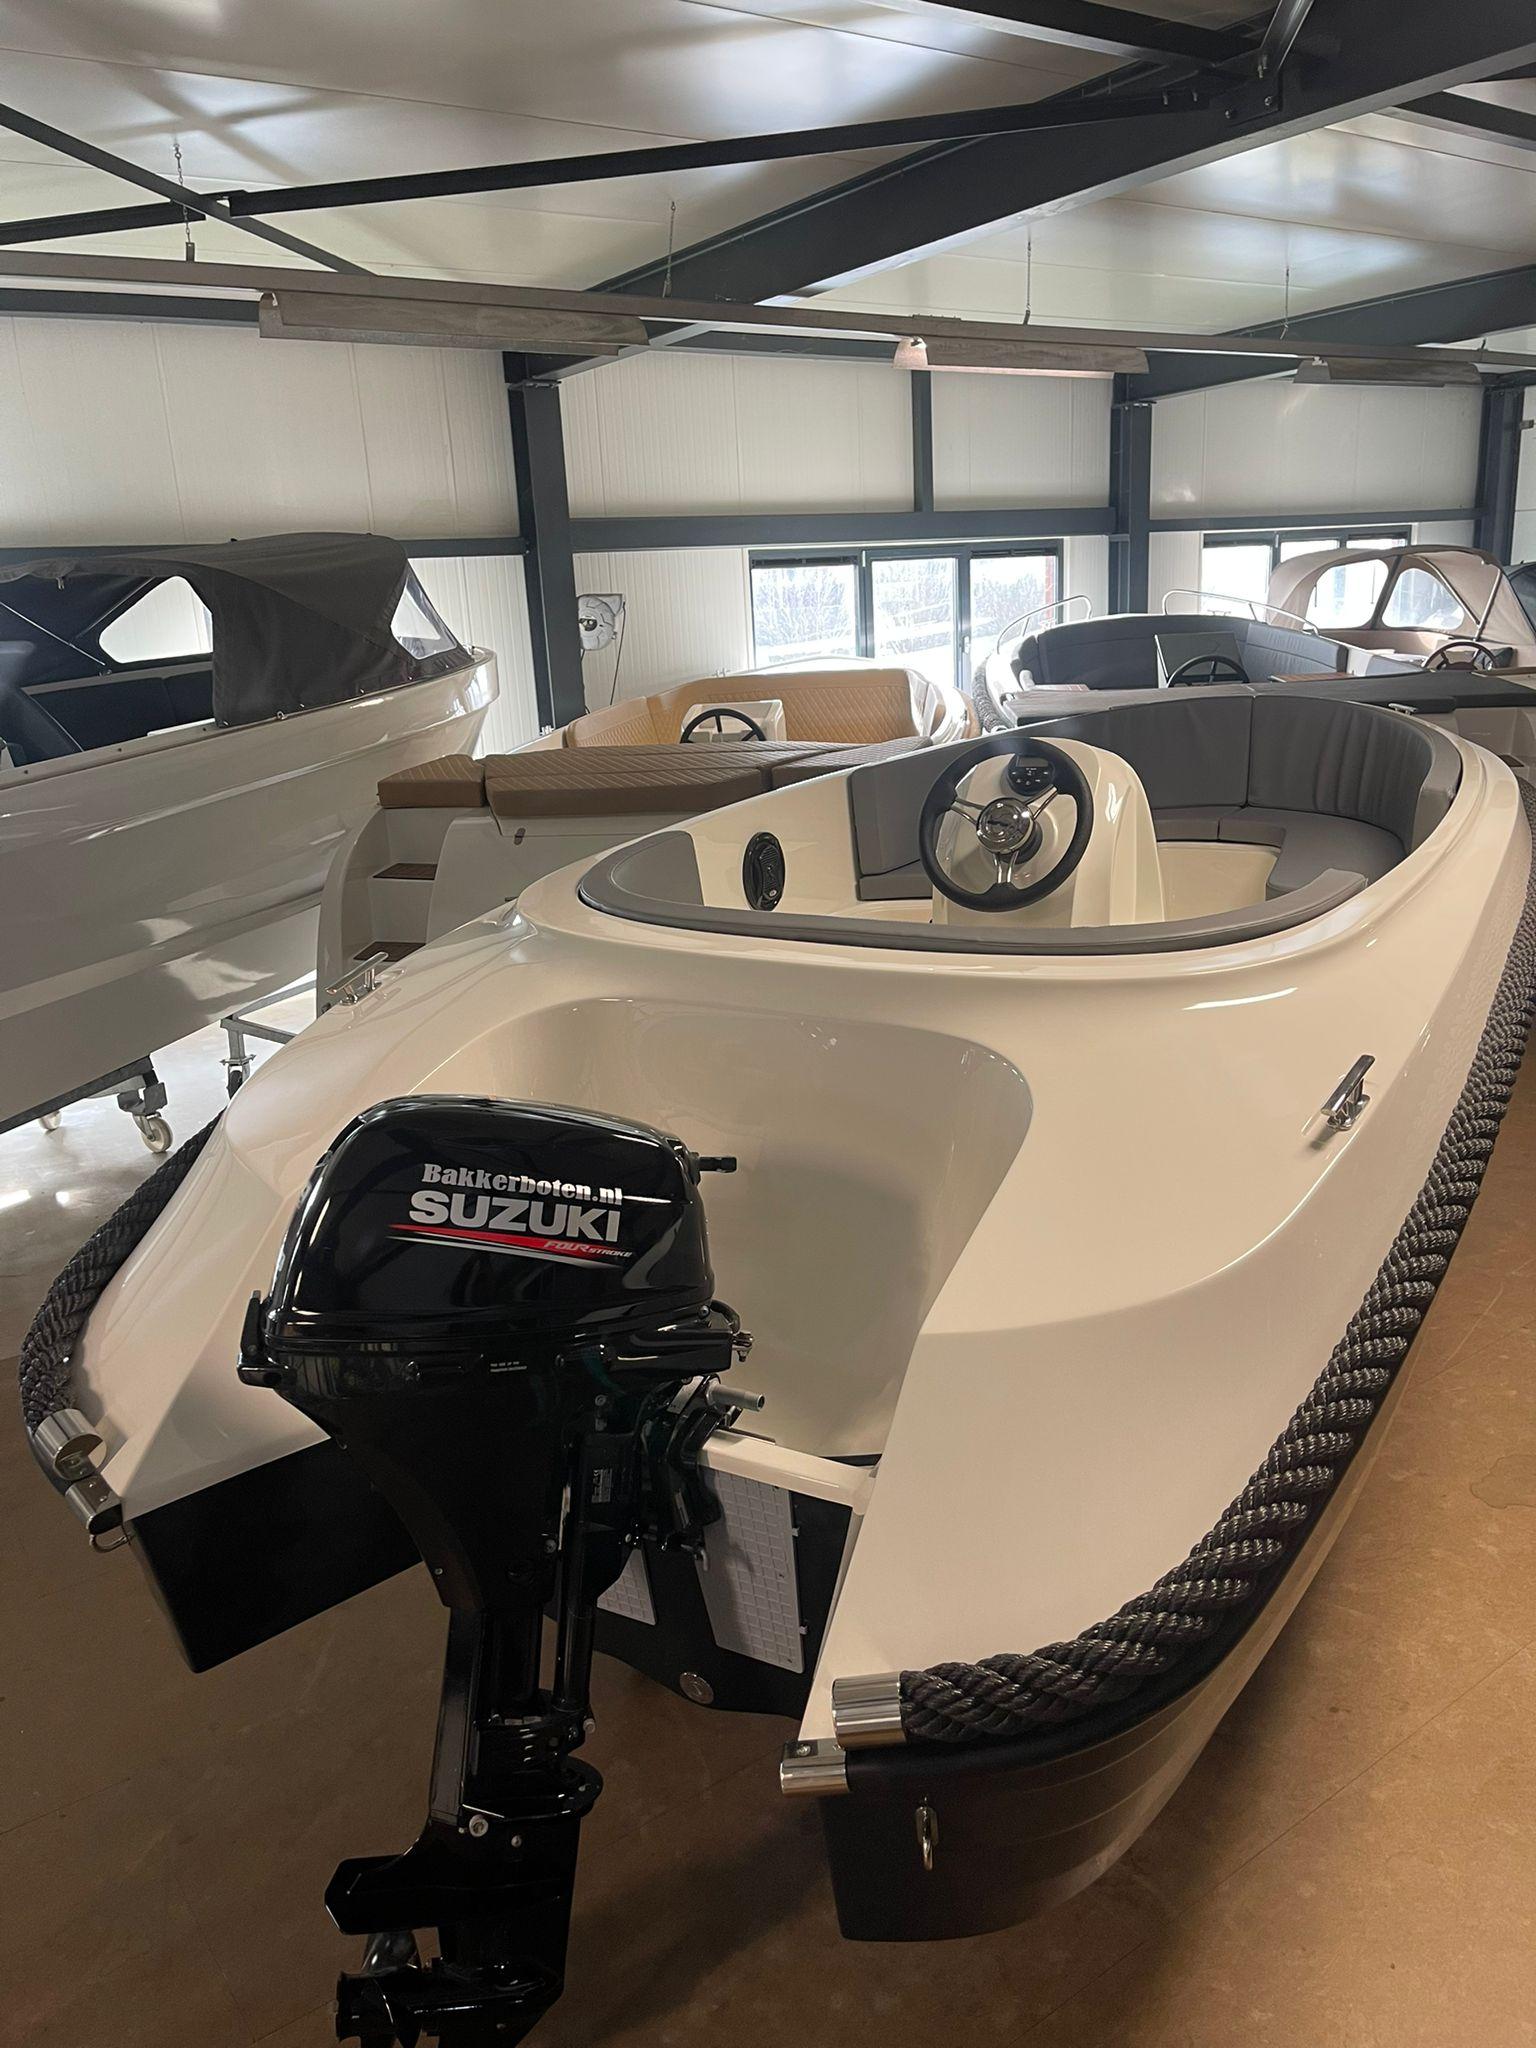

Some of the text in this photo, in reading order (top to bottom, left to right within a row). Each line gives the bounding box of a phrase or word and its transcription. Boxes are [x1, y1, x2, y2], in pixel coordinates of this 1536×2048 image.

[422, 1163, 622, 1205] Bakkerboten.nl
[409, 1190, 621, 1242] SUZUKI
[543, 1240, 633, 1258] FOUR STROKE
